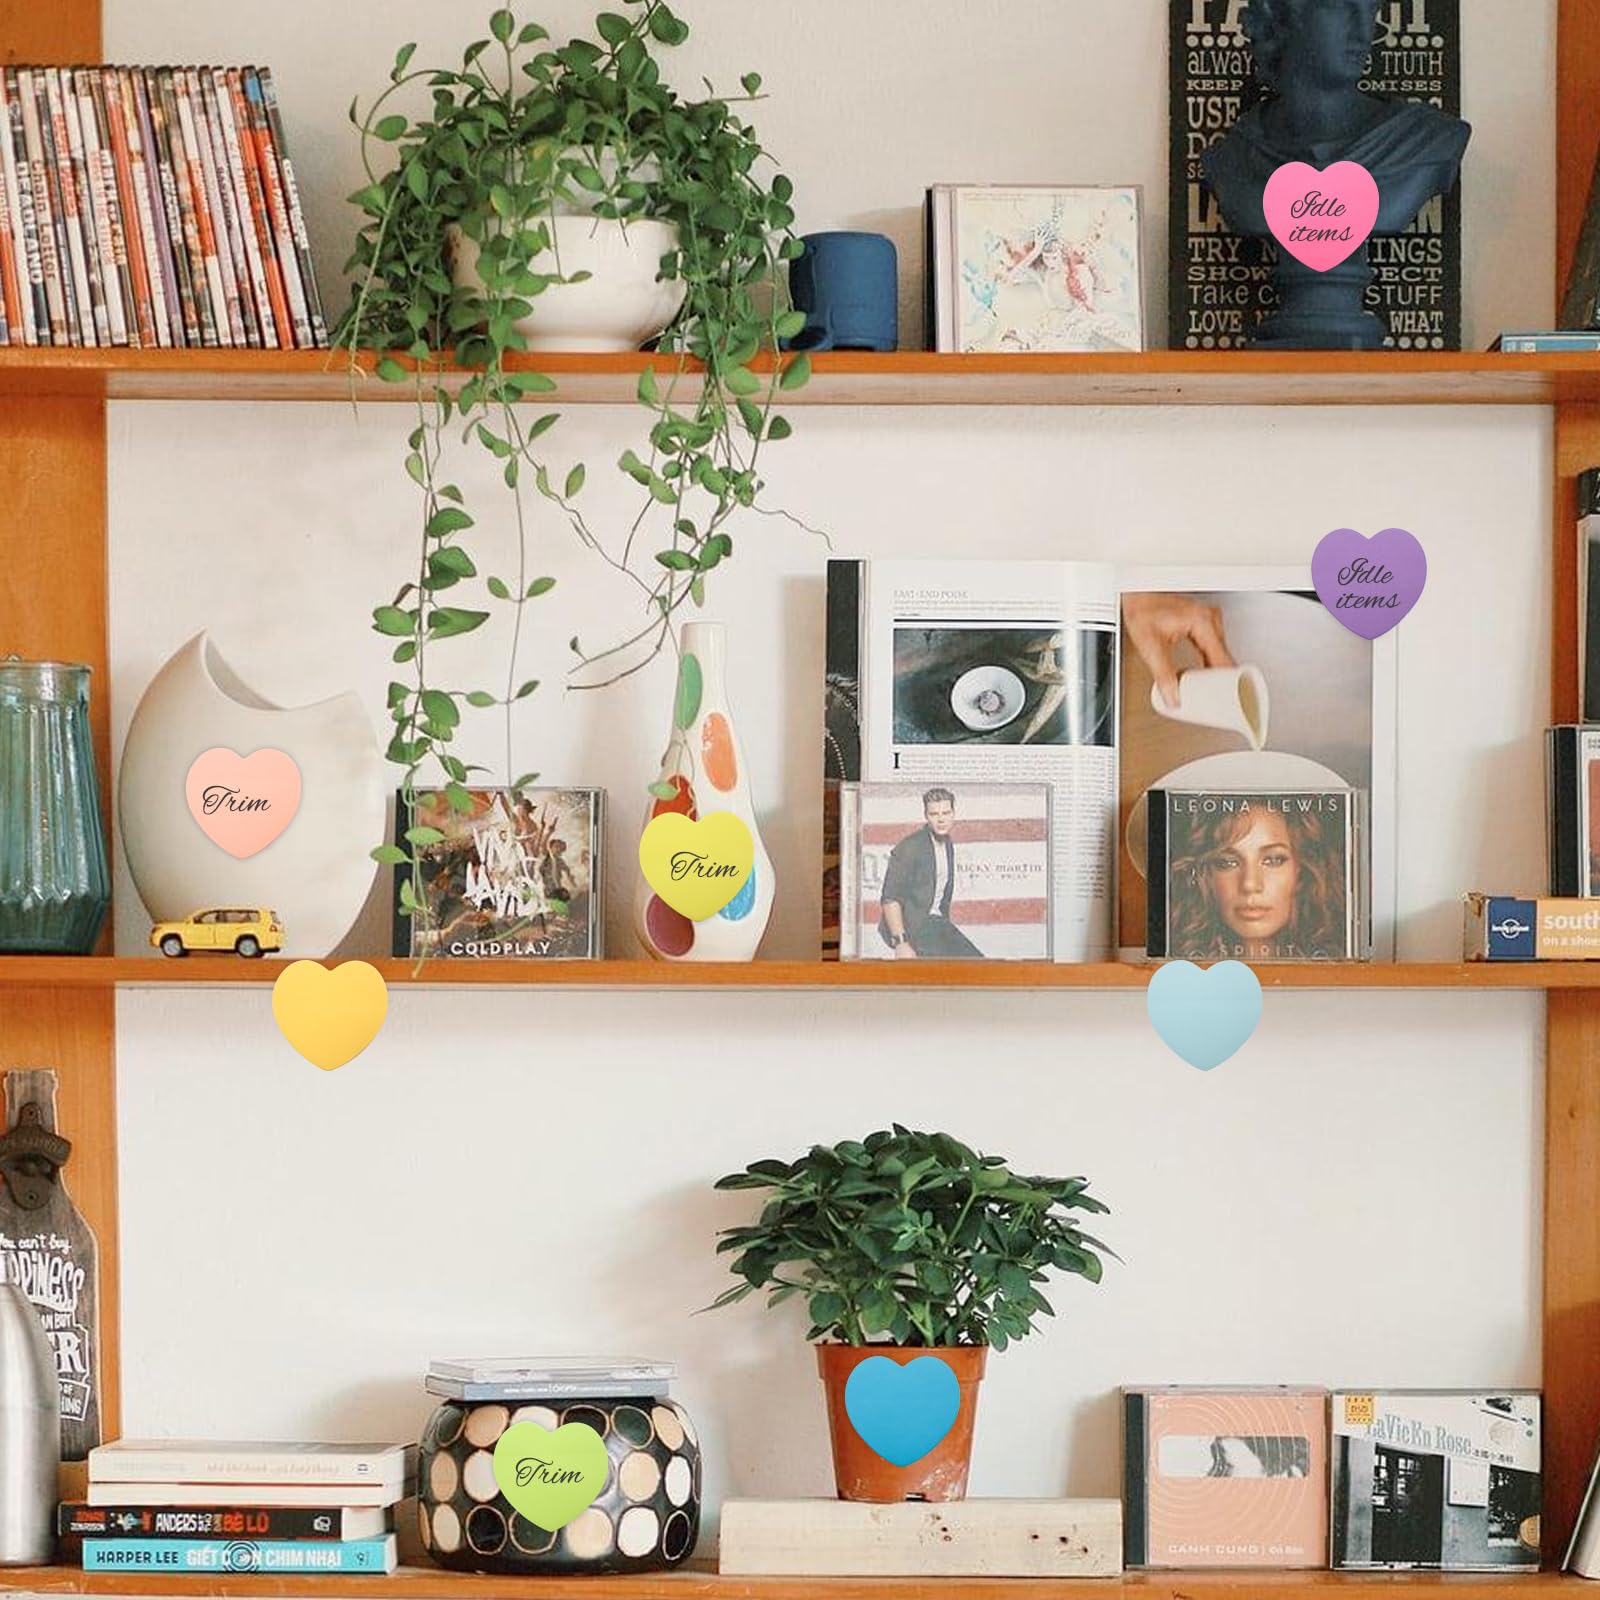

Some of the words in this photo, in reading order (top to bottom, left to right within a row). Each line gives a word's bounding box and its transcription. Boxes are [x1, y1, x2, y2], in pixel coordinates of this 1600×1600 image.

[1186, 80, 1244, 91] KEEP
[1357, 80, 1442, 92] OMISES
[16, 161, 43, 285] DEADLAND
[1188, 237, 1242, 262] TRY
[1365, 238, 1443, 263] INGS
[1188, 266, 1271, 281] SHOW
[1365, 285, 1444, 305] STUFF
[1189, 310, 1242, 333] LOVE
[1390, 310, 1443, 333] WHAT
[1174, 799, 1251, 813] LEONA
[1267, 798, 1338, 813] LEWIS
[450, 942, 551, 955] COLDPLAY
[1219, 944, 1294, 958] SPIRIT
[18, 1233, 47, 1249] can't
[49, 1233, 72, 1254] buy
[1435, 1425, 1472, 1455] Rose
[156, 1513, 197, 1532] ANDERS
[97, 1551, 152, 1564] HARPER
[156, 1552, 179, 1563] LEE
[265, 1549, 305, 1566] CHIM
